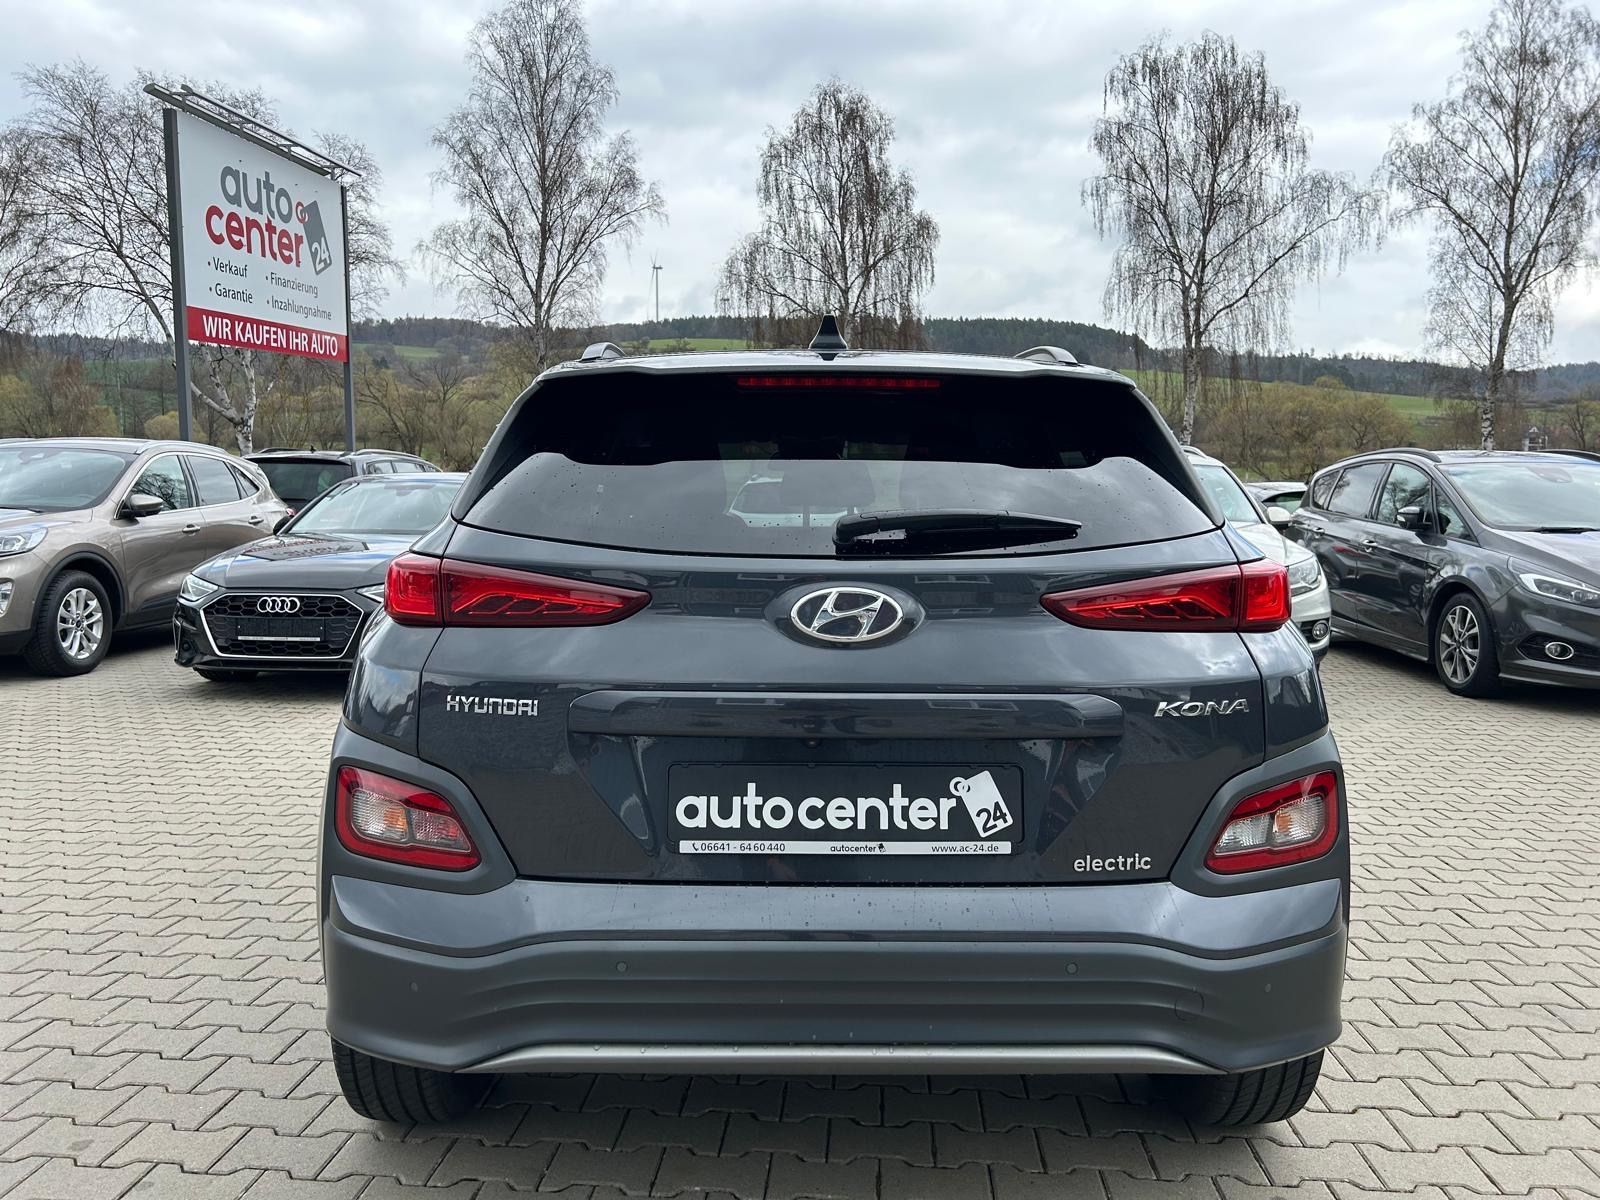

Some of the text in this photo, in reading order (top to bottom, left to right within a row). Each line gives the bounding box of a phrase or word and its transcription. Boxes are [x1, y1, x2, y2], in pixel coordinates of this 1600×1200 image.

[220, 165, 293, 224] auto
[205, 205, 304, 267] center
[311, 237, 330, 272] 24
[212, 256, 248, 278] Verkauf
[214, 282, 253, 304] Garantie
[270, 272, 318, 299] Finanzierung
[271, 296, 332, 320] Inzahlungnahme
[202, 314, 338, 357] WIR KAUFEN IHR AUTO
[446, 695, 539, 716] HYUNDAI
[1153, 698, 1250, 717] KONA
[974, 800, 1008, 834] 24
[700, 842, 731, 852] 06641
[829, 844, 877, 853] autocenter
[931, 843, 999, 853] www.ac-24.de
[1073, 852, 1152, 872] electric
